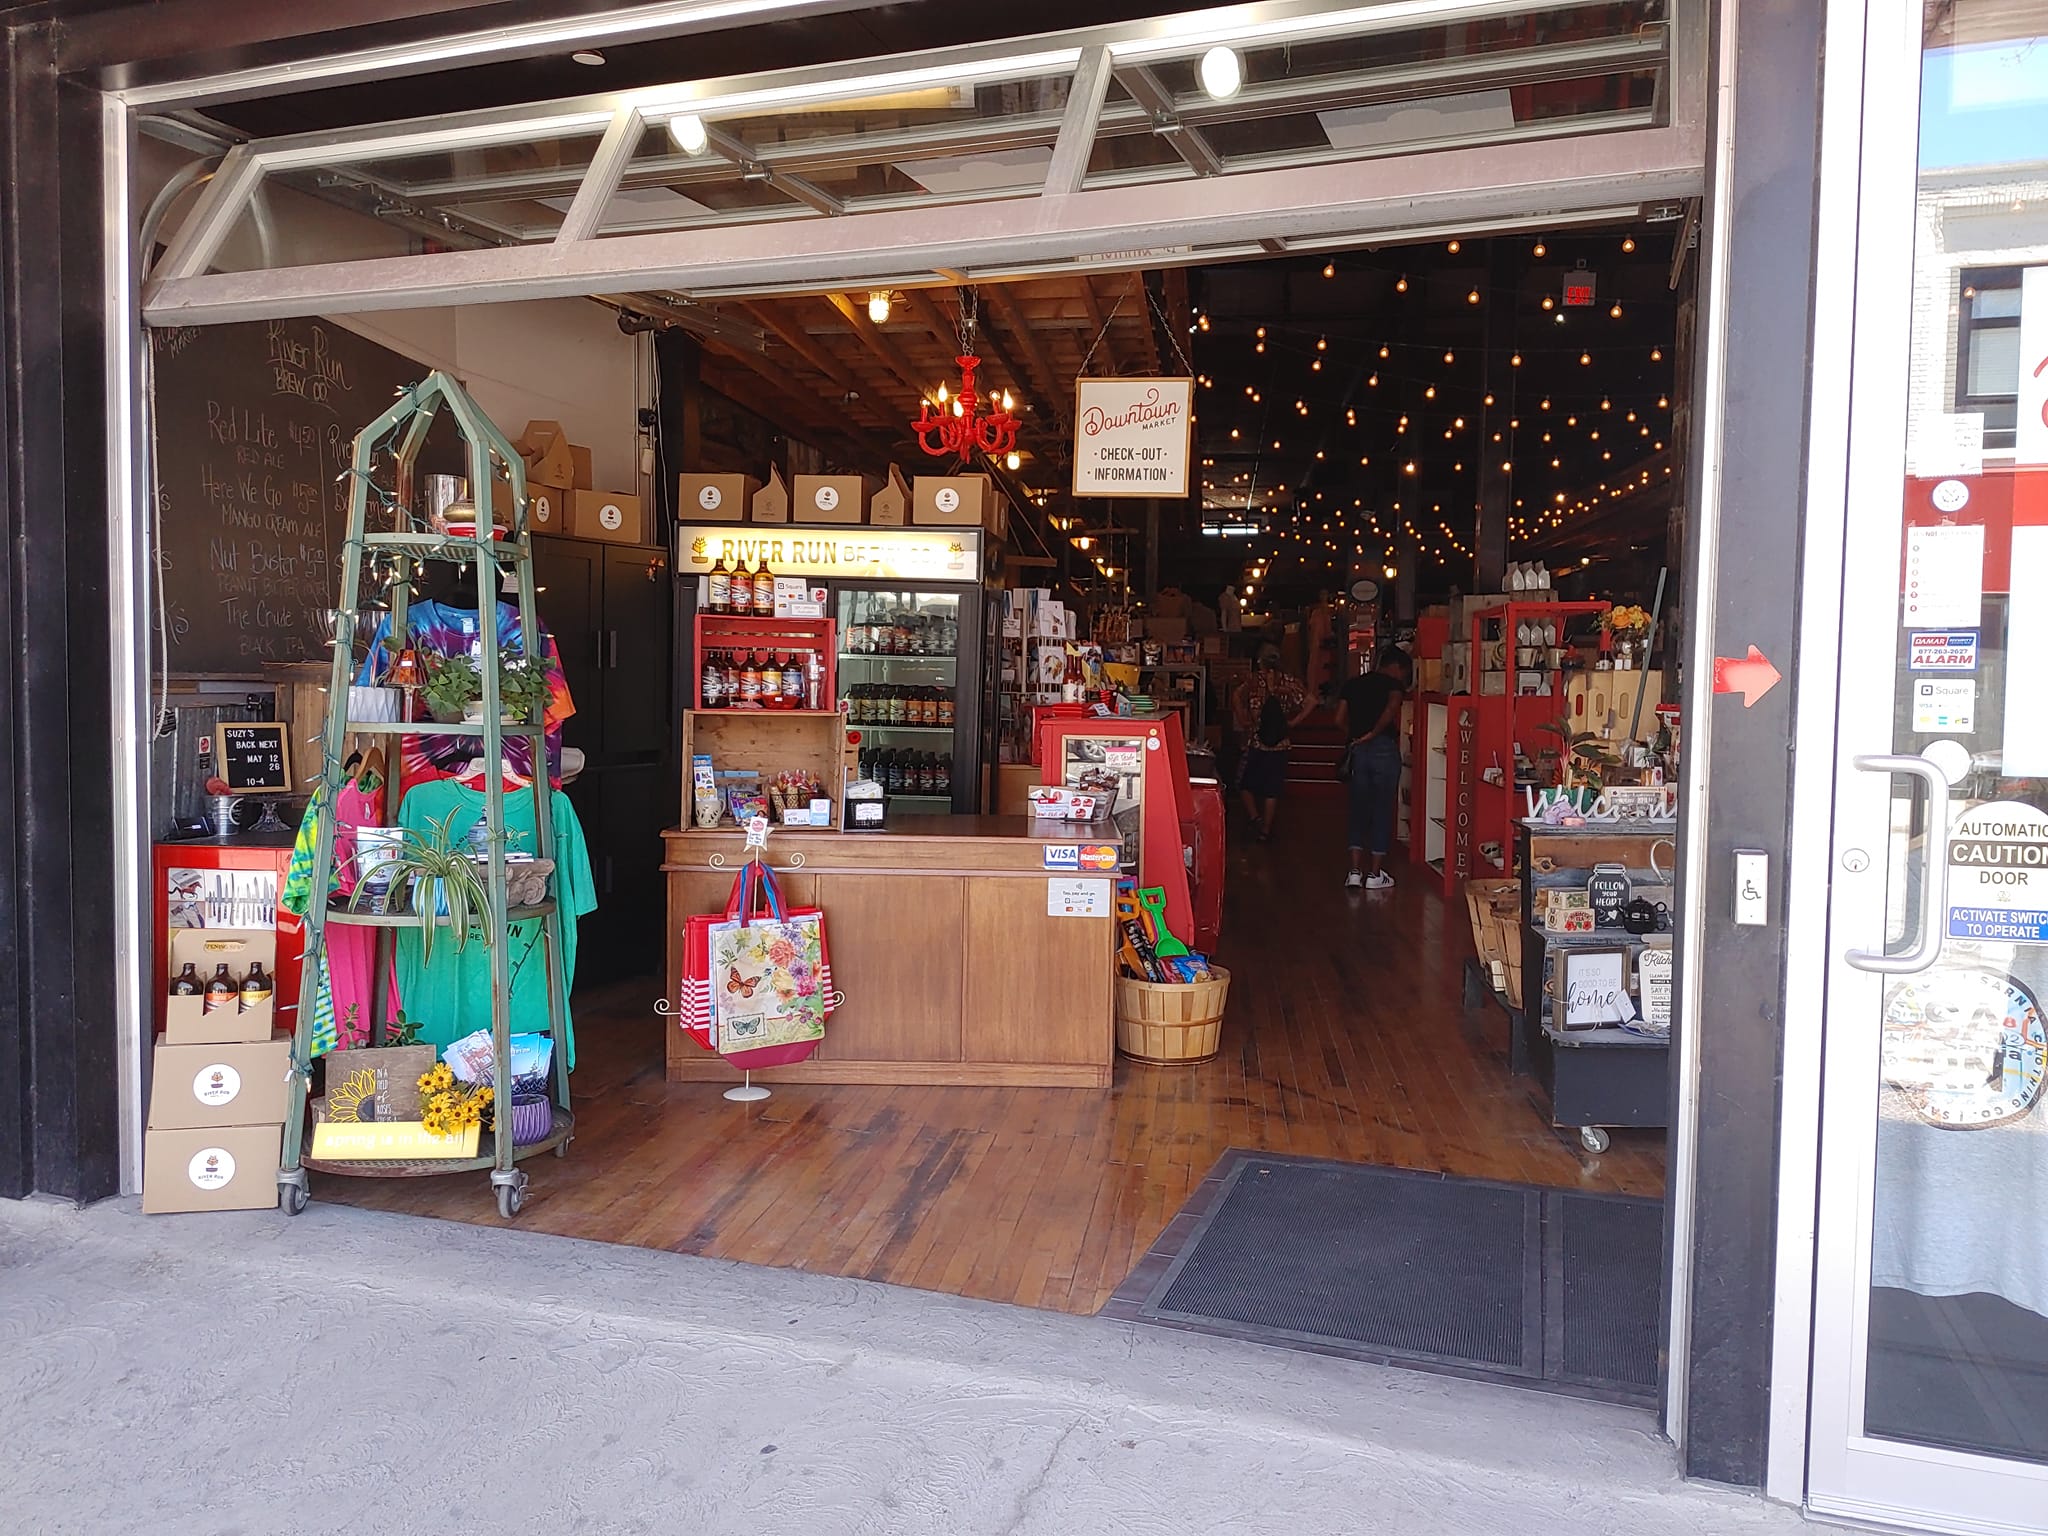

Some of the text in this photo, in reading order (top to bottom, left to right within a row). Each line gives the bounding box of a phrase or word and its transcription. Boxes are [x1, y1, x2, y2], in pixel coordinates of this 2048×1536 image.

[266, 320, 352, 391] River Run
[273, 367, 308, 399] BREW
[1082, 388, 1181, 436] Downtown
[207, 400, 238, 444] Red
[245, 409, 279, 449] Lite
[1142, 417, 1176, 431] MARKET
[263, 453, 286, 469] ALE
[1100, 447, 1162, 461] CHECK-OUT
[1094, 466, 1167, 481] INFORMATION
[201, 463, 235, 504] Here
[239, 472, 258, 502] We
[221, 503, 324, 538] MANGO CREAM ALE
[210, 537, 241, 572] Nut
[721, 539, 785, 562] RIVER
[792, 541, 837, 563] RUN
[219, 596, 251, 630] The
[256, 600, 294, 629] Crude
[1912, 655, 1973, 664] ALARM
[1935, 686, 1969, 695] Square
[226, 730, 255, 738] SUZY'S
[236, 740, 278, 749] BACK NEXT
[247, 754, 279, 763] MAY 12
[246, 778, 265, 786] 10-4
[1456, 731, 1472, 867] WELCOME
[1050, 849, 1076, 859] VISA
[1980, 871, 2028, 885] DOOR
[1594, 881, 1625, 890] FOLLOW
[1595, 898, 1623, 907] HEART
[1952, 909, 2007, 922] ACTIVATE
[1966, 924, 2040, 938] TO OPERATE
[1591, 968, 1600, 976] SO
[1579, 979, 1616, 988] GOOD TO BE
[1567, 982, 1618, 1013] home
[1980, 976, 2037, 1026] SARNIA
[376, 1090, 390, 1103] of
[326, 1135, 376, 1148] spring
[381, 1134, 393, 1145] is
[400, 1134, 413, 1145] in
[417, 1133, 439, 1144] the
